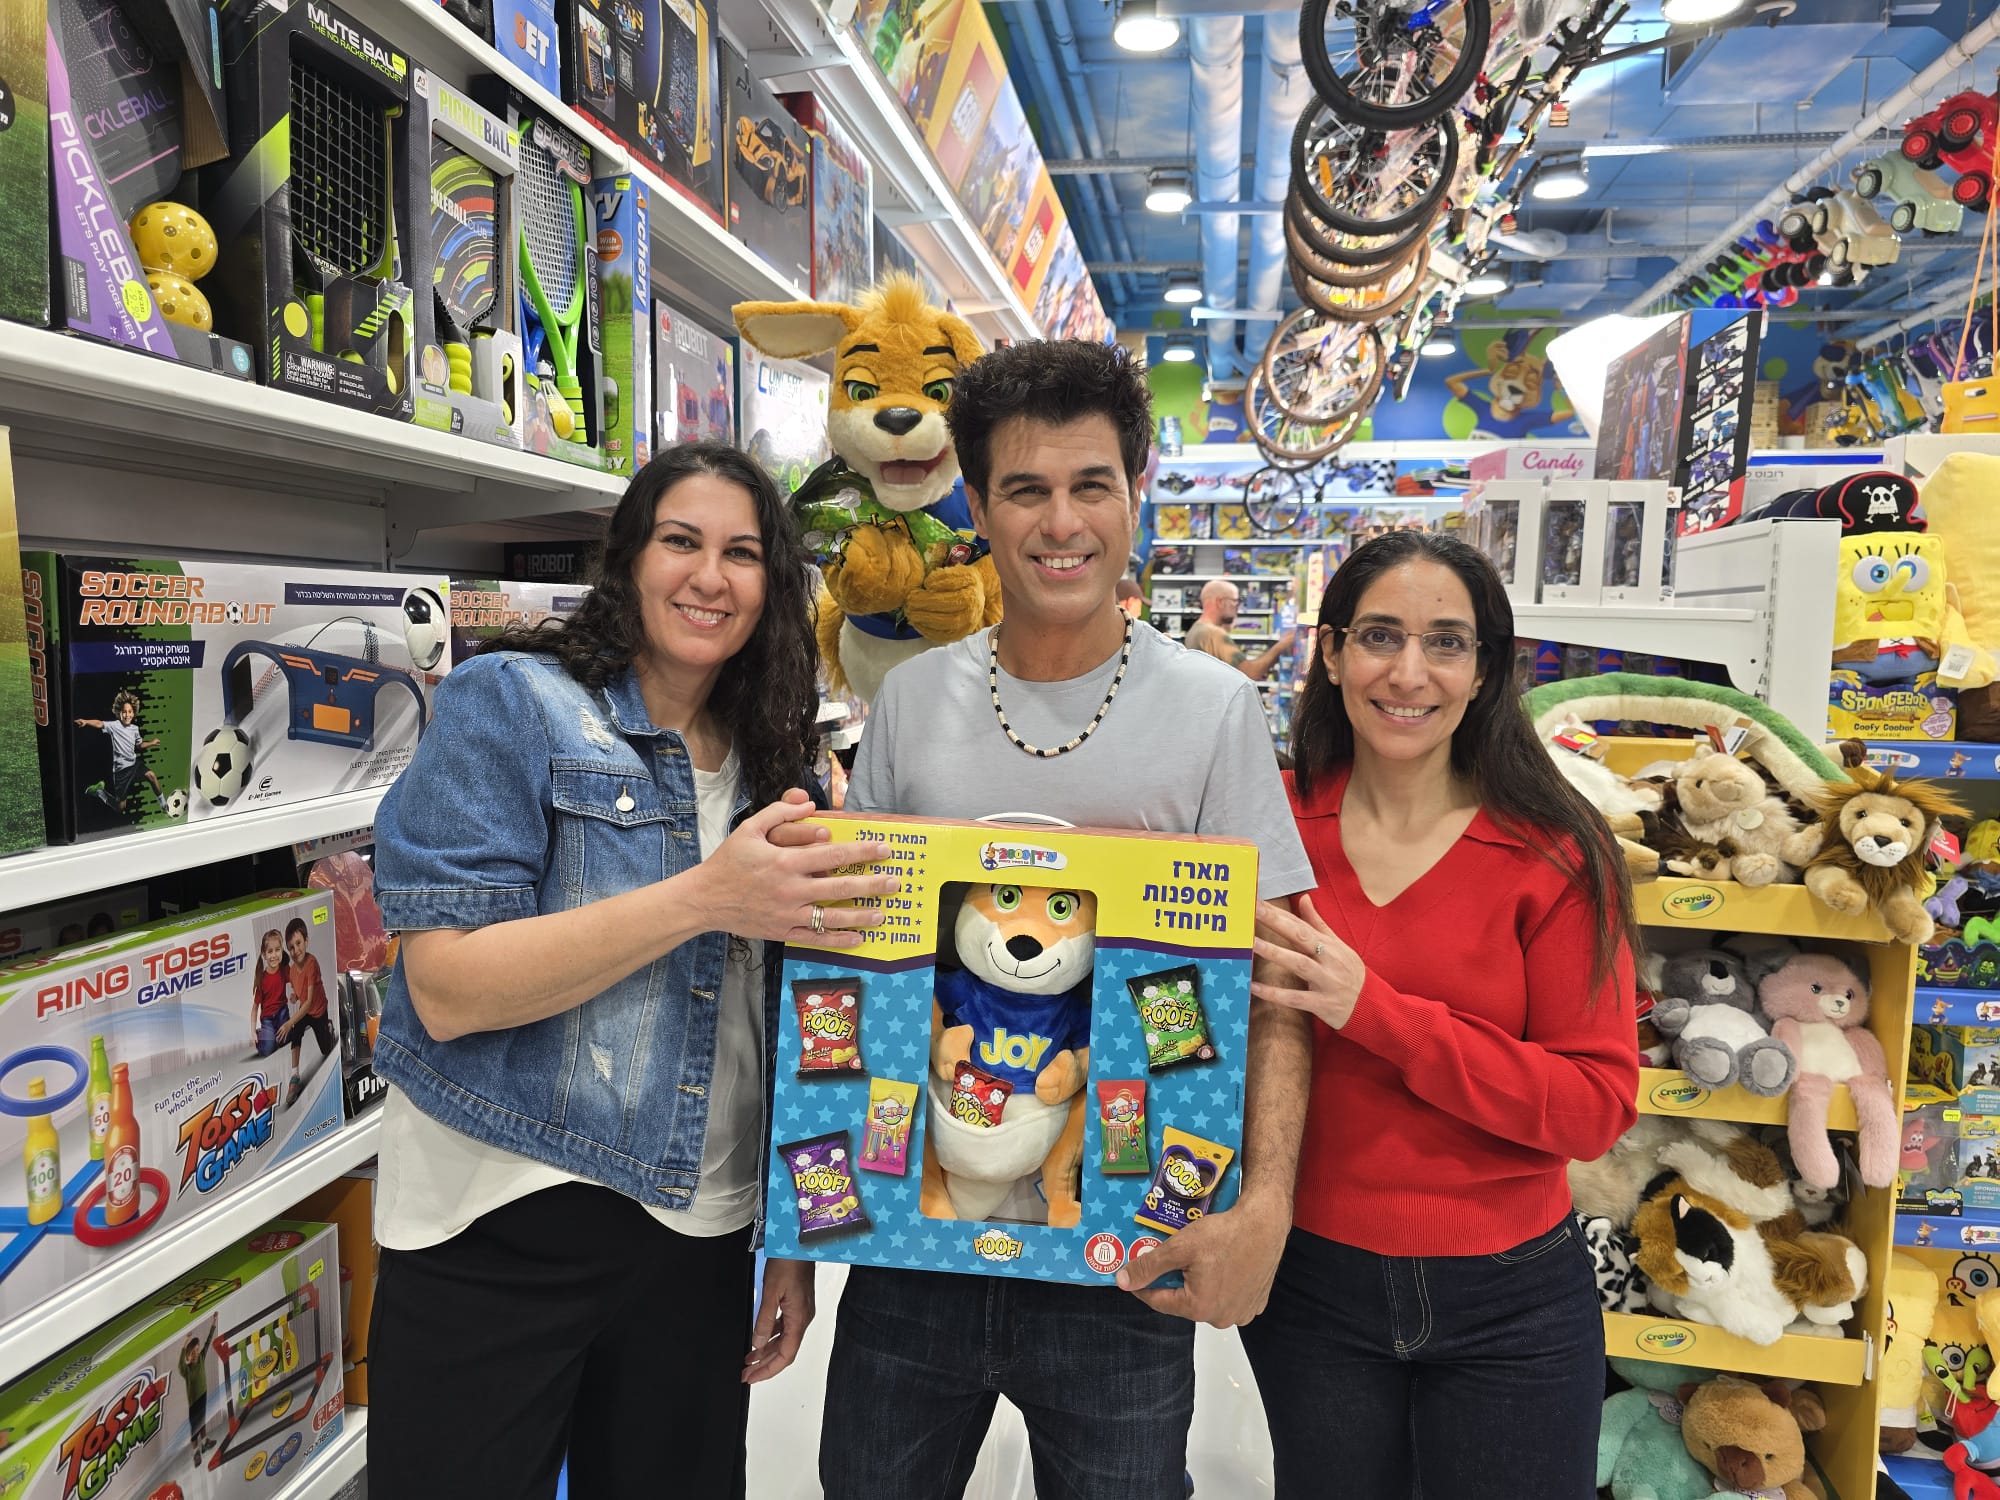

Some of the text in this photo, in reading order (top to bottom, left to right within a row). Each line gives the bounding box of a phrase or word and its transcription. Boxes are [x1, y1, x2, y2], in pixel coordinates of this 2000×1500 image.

[308, 2, 360, 49] MUTE
[513, 12, 549, 67] SET
[310, 20, 403, 83] THE NO RACKET RACQUET
[439, 87, 511, 158] PICKLEBALL
[533, 117, 587, 175] SPORTS
[635, 187, 649, 308] Archery
[75, 204, 137, 341] LET'S PLAY TOGETHER
[300, 356, 335, 376] WARNING:
[1523, 451, 1584, 477] Candy
[532, 554, 574, 573] ROBOT
[80, 571, 204, 598] SOCCER
[450, 591, 510, 608] SOCCER
[80, 600, 276, 626] ROUNDABOUT
[114, 643, 190, 658] משחק אימון כדורגל
[140, 655, 190, 666] אינטראקטיבי
[1842, 690, 1928, 711] SPONGEBOB
[351, 834, 372, 845] SPORTS
[855, 830, 927, 845] המארז כולל:
[870, 864, 902, 876] חטיפי
[906, 867, 913, 876] 4
[1173, 860, 1229, 881] מארז
[905, 883, 912, 893] 2
[1143, 884, 1228, 907] אספנות
[1673, 893, 1712, 905] Crayola
[886, 898, 912, 909] שלט
[1154, 909, 1226, 932] מיוחד!
[890, 932, 920, 944] והמון
[36, 933, 230, 1020] RING TOSS
[137, 953, 248, 1006] GAME SET
[802, 1011, 855, 1040] POOF!
[1141, 1005, 1198, 1031] POOF!
[980, 1028, 1053, 1072] JOY
[154, 1076, 201, 1112] Fun for the
[167, 1071, 222, 1115] whole family!
[1660, 1086, 1698, 1096] Crayola
[95, 1112, 110, 1126] 50
[175, 1082, 258, 1195] TOSS
[196, 1109, 273, 1193] GAME
[31, 1168, 55, 1187] 100
[114, 1168, 132, 1188] 20
[795, 1172, 851, 1193] POOF!
[1163, 1156, 1205, 1197] POOF!
[973, 1237, 1024, 1257] POOF!
[1097, 1234, 1115, 1243] נתרן
[1141, 1238, 1158, 1247] סוכר
[1646, 1332, 1684, 1341] Crayola
[57, 1380, 142, 1500] TOSS
[78, 1402, 160, 1500] GAME
